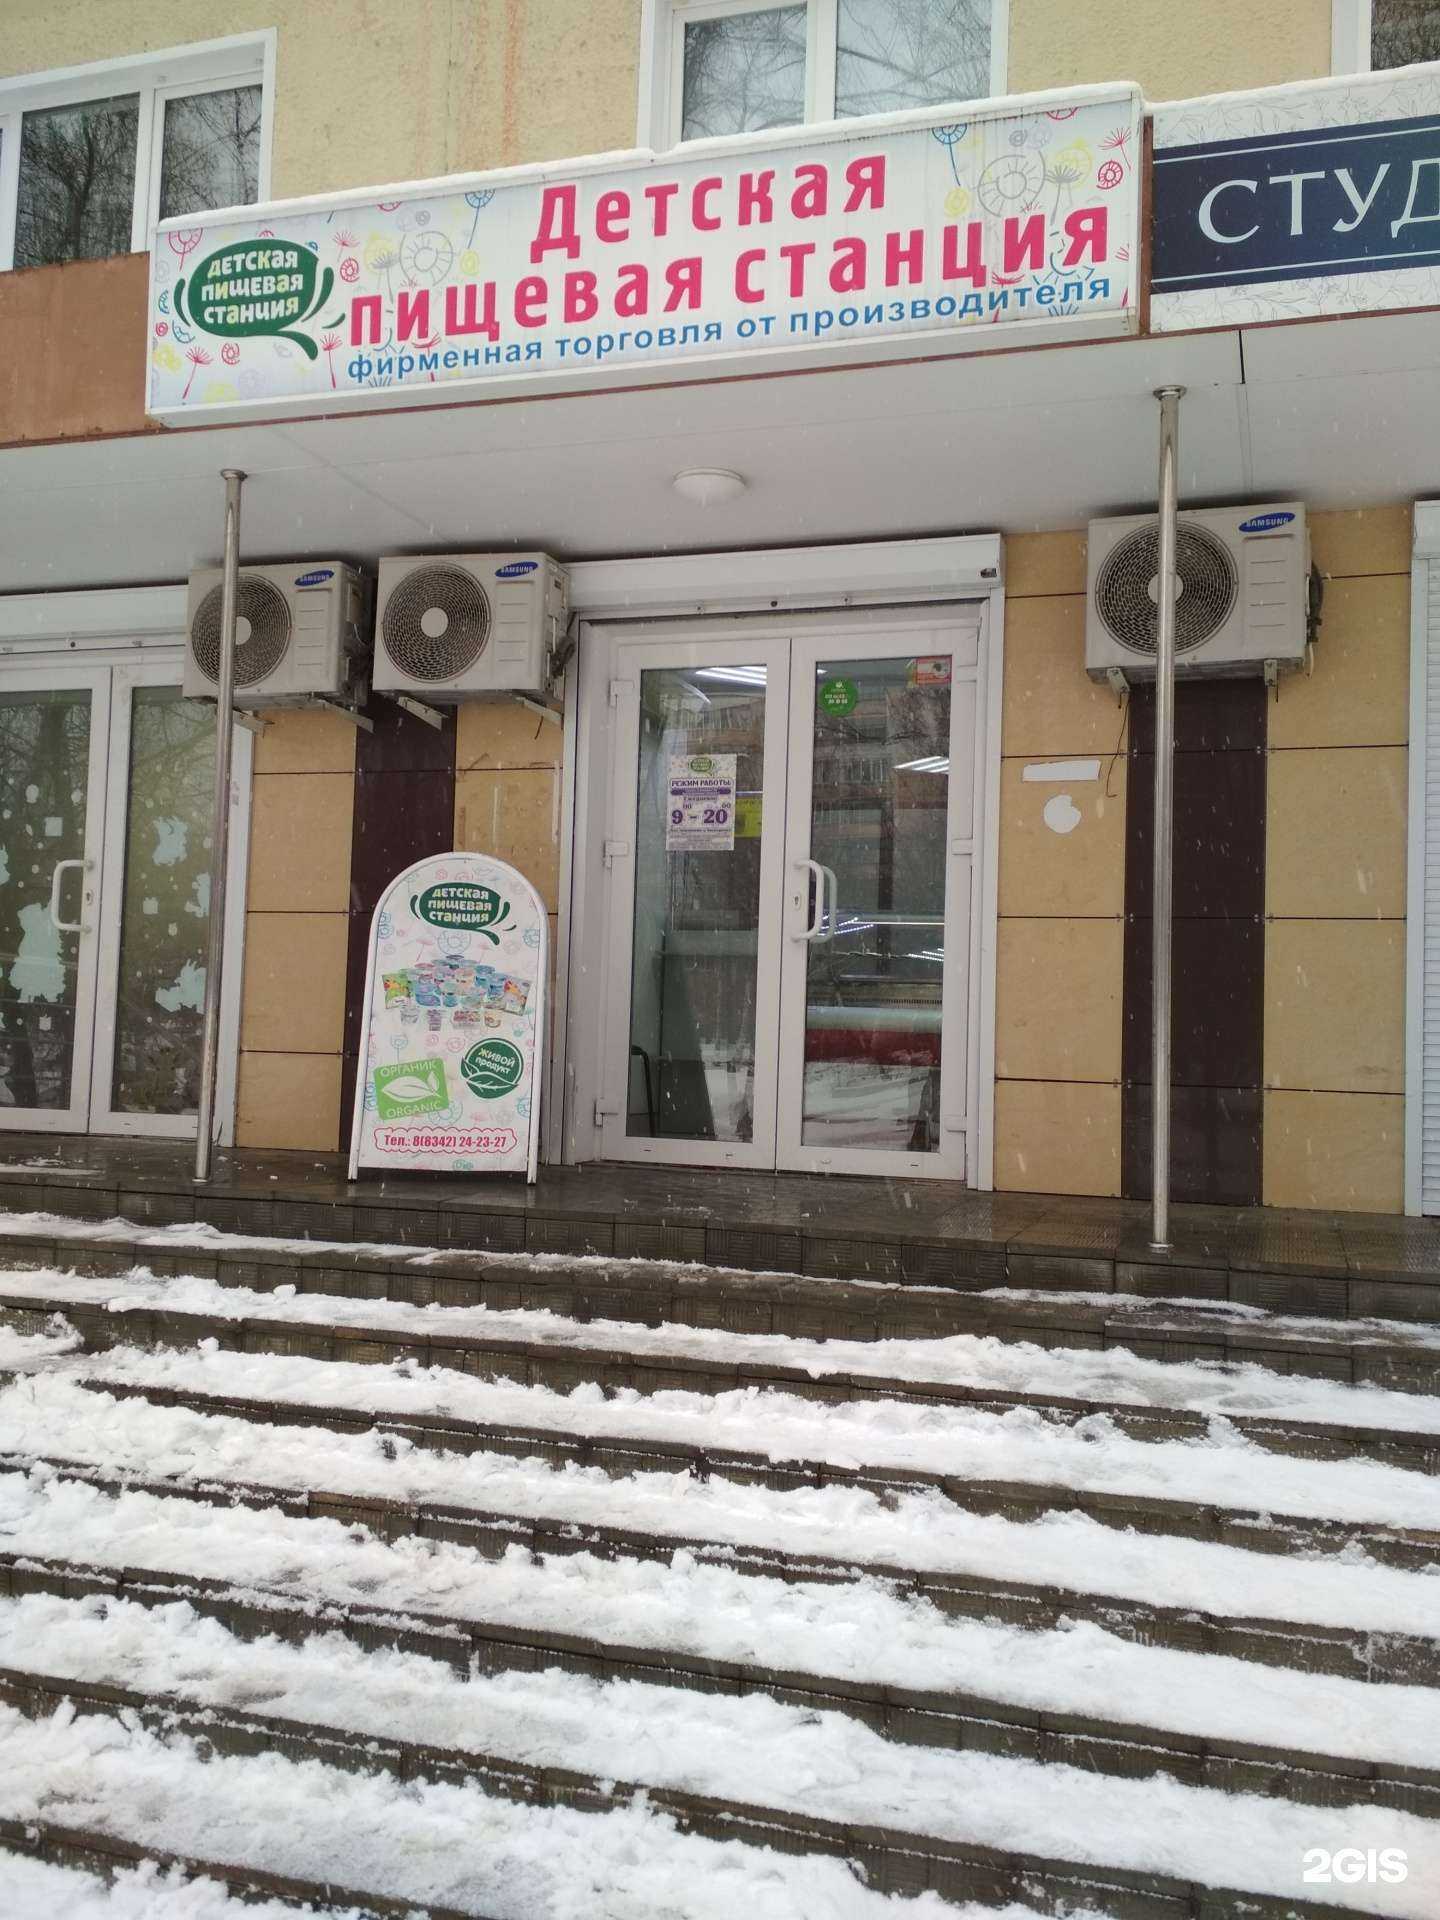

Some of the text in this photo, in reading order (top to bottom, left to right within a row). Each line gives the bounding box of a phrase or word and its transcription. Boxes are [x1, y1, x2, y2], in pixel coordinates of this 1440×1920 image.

[530, 155, 886, 264] Детская
[350, 206, 1108, 346] пищевая станция
[347, 277, 1110, 383] фирменная торговля от производителя
[1244, 515, 1291, 529] SAMSUNG
[498, 564, 536, 576] SAMSUNG
[672, 809, 684, 825] 9
[703, 809, 728, 824] 20
[475, 1056, 511, 1075] продукт
[478, 1047, 516, 1068] ЖИВОЙ
[380, 1058, 438, 1078] ОРГАНИК
[386, 1100, 443, 1118] ORGANIC
[459, 1136, 507, 1148] 24-23-27
